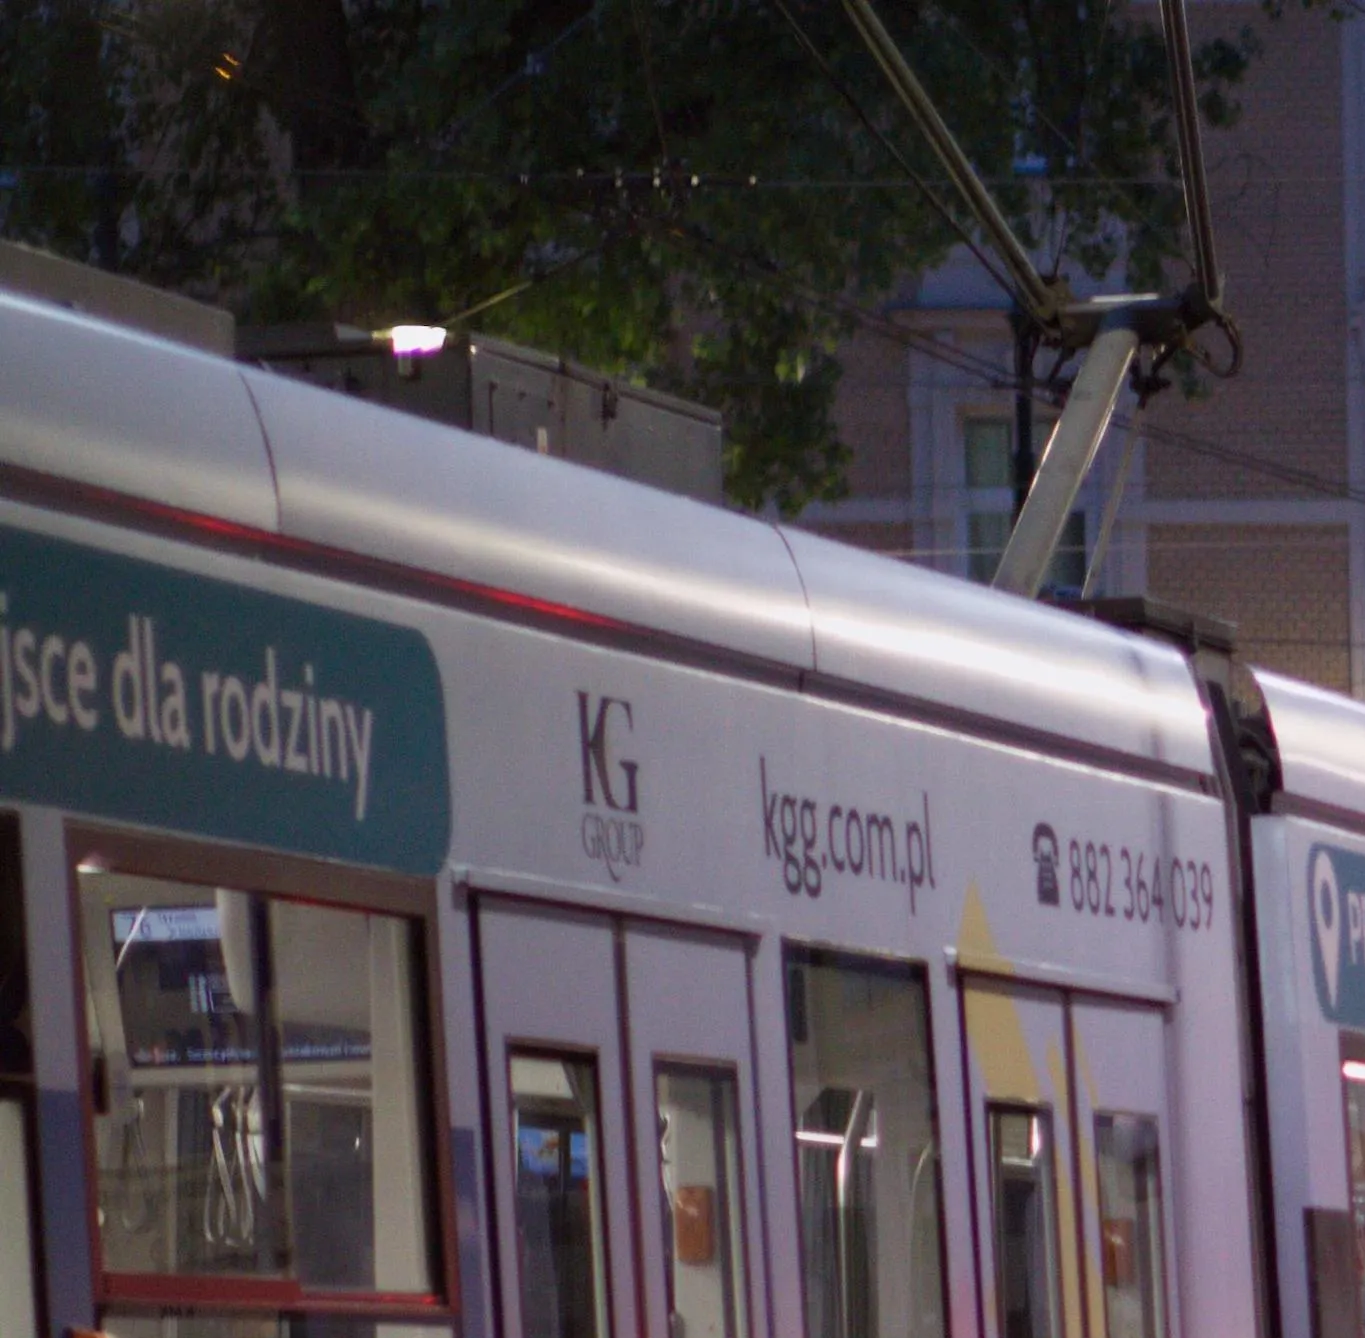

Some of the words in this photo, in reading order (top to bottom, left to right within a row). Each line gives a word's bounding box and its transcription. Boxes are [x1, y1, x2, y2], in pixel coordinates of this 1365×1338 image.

[112, 611, 191, 750] dla
[202, 645, 373, 821] rodziny
[576, 690, 638, 813] KG
[759, 754, 936, 914] kgg.com.pl
[1069, 838, 1116, 917] 882
[1121, 846, 1165, 924] 364
[1170, 855, 1214, 930] 039
